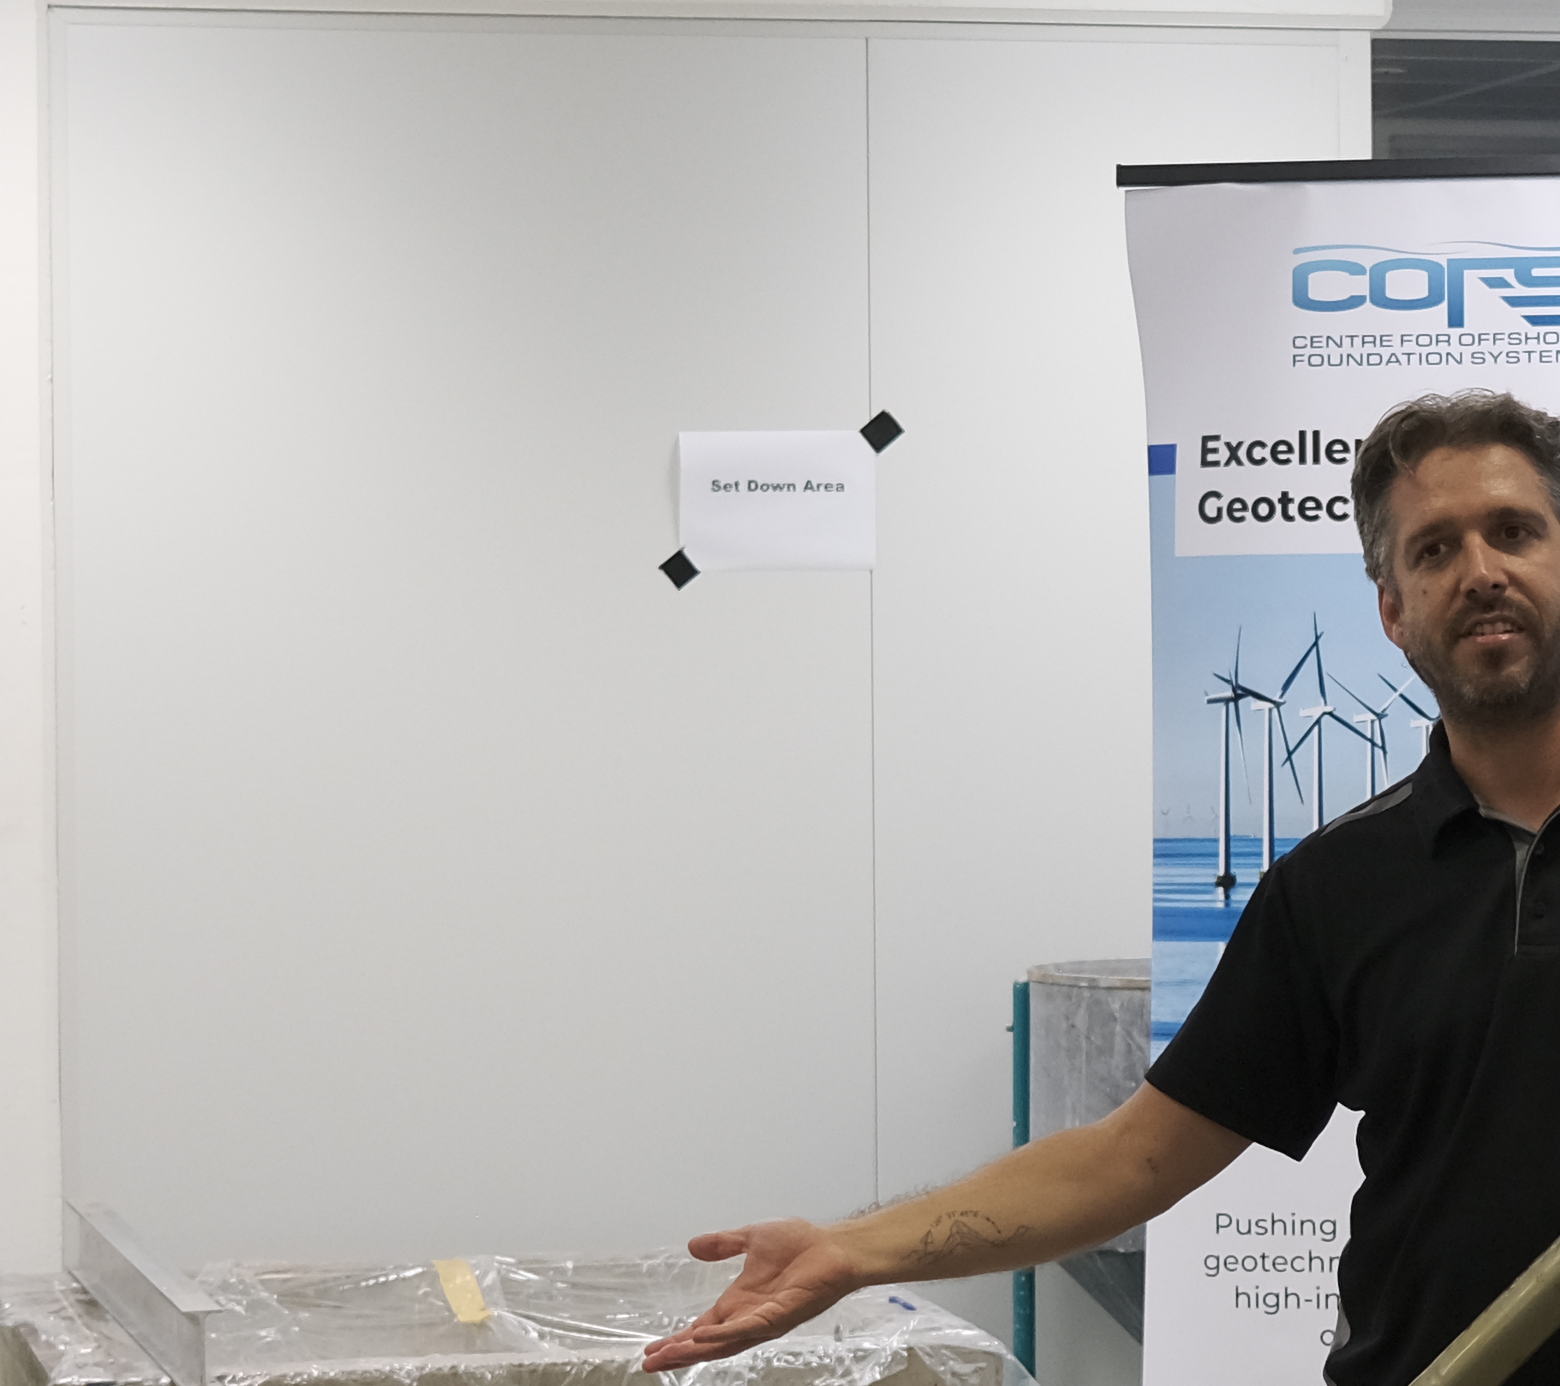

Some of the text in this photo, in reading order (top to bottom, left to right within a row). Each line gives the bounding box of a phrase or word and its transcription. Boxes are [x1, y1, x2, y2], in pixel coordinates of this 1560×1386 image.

[1292, 334, 1394, 349] CENTRE
[1400, 333, 1452, 348] FOR
[1292, 351, 1463, 368] FOUNDATION
[1199, 429, 1363, 468] Excelle
[711, 479, 845, 493] Set Down Area
[1198, 489, 1352, 525] Geotec
[1215, 1212, 1337, 1242] Pushing
